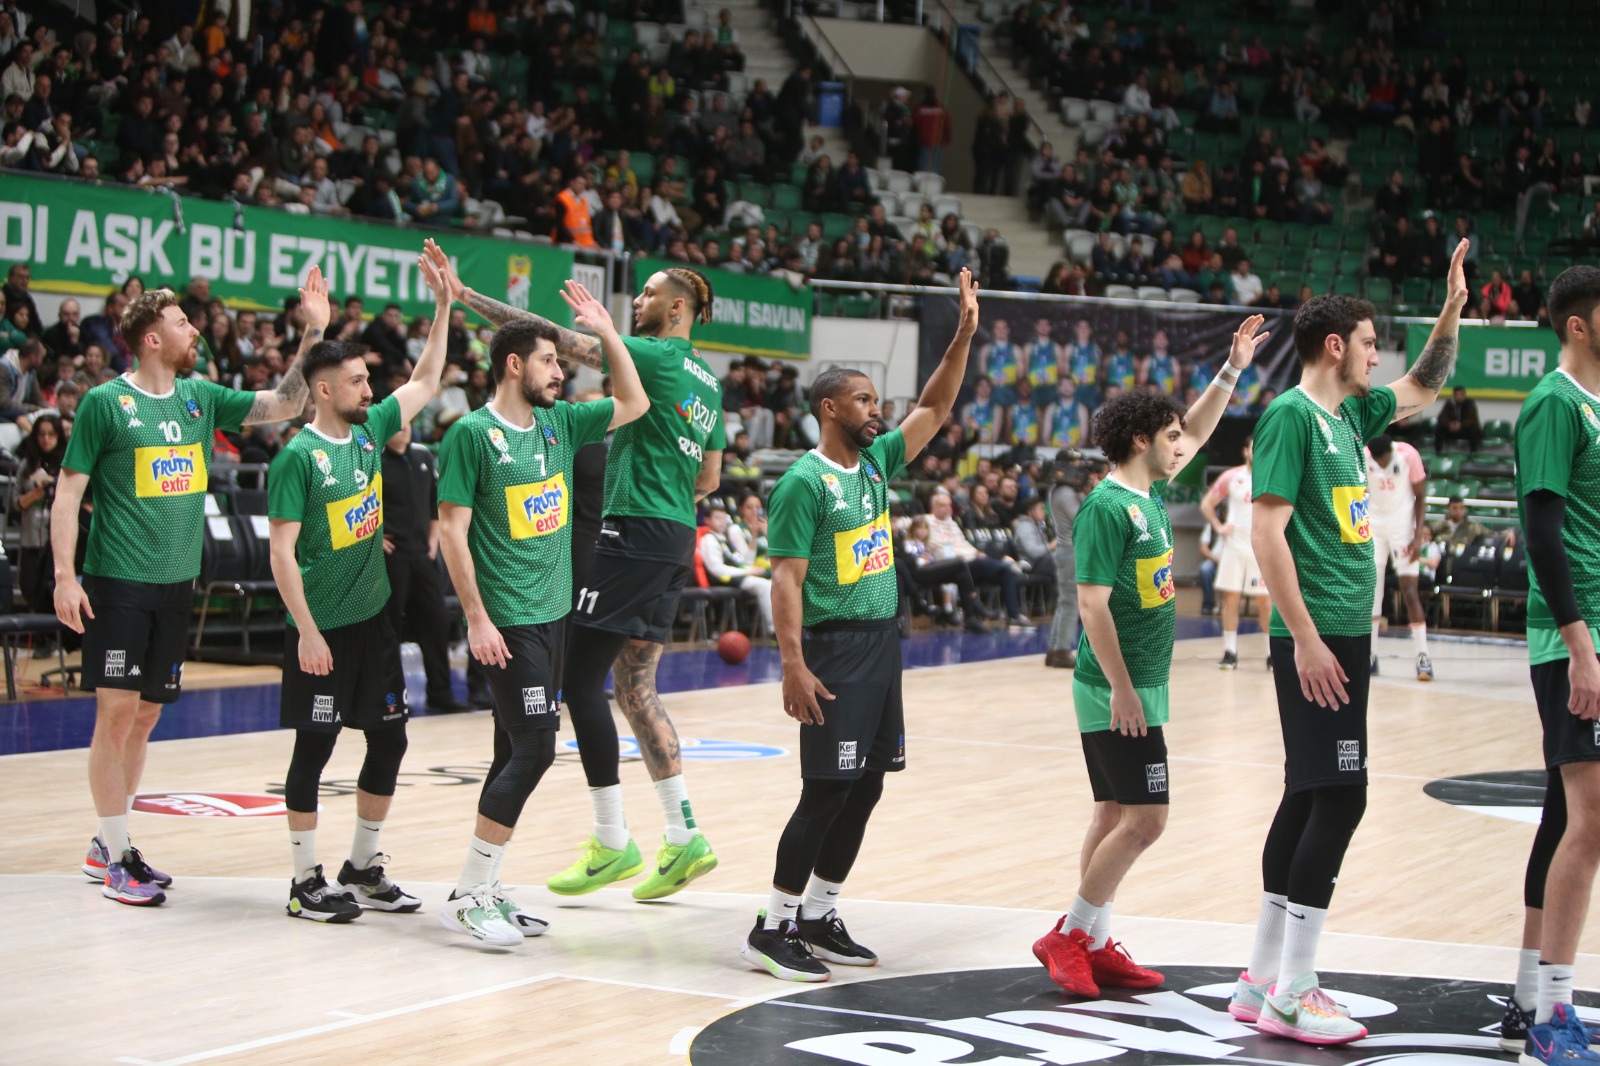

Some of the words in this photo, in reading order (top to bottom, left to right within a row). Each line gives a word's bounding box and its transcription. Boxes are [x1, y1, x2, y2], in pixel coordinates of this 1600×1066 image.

[64, 209, 176, 286] AŞK
[684, 356, 718, 392] AUGUSTE
[159, 420, 182, 443] 10
[534, 453, 546, 476] 7
[161, 478, 190, 493] extra
[862, 493, 873, 520] 5
[576, 587, 600, 615] 11
[106, 650, 125, 661] Kent
[105, 666, 124, 676] AVM
[523, 688, 545, 699] Kent
[314, 695, 334, 706] Kent
[526, 701, 547, 714] AVM
[313, 710, 333, 722] AVM
[839, 742, 857, 752] Kent
[1338, 741, 1360, 752] Kent
[840, 758, 856, 769] AVM
[1146, 763, 1166, 775] Kent
[1339, 758, 1360, 770] AVM
[1149, 780, 1167, 792] AVM
